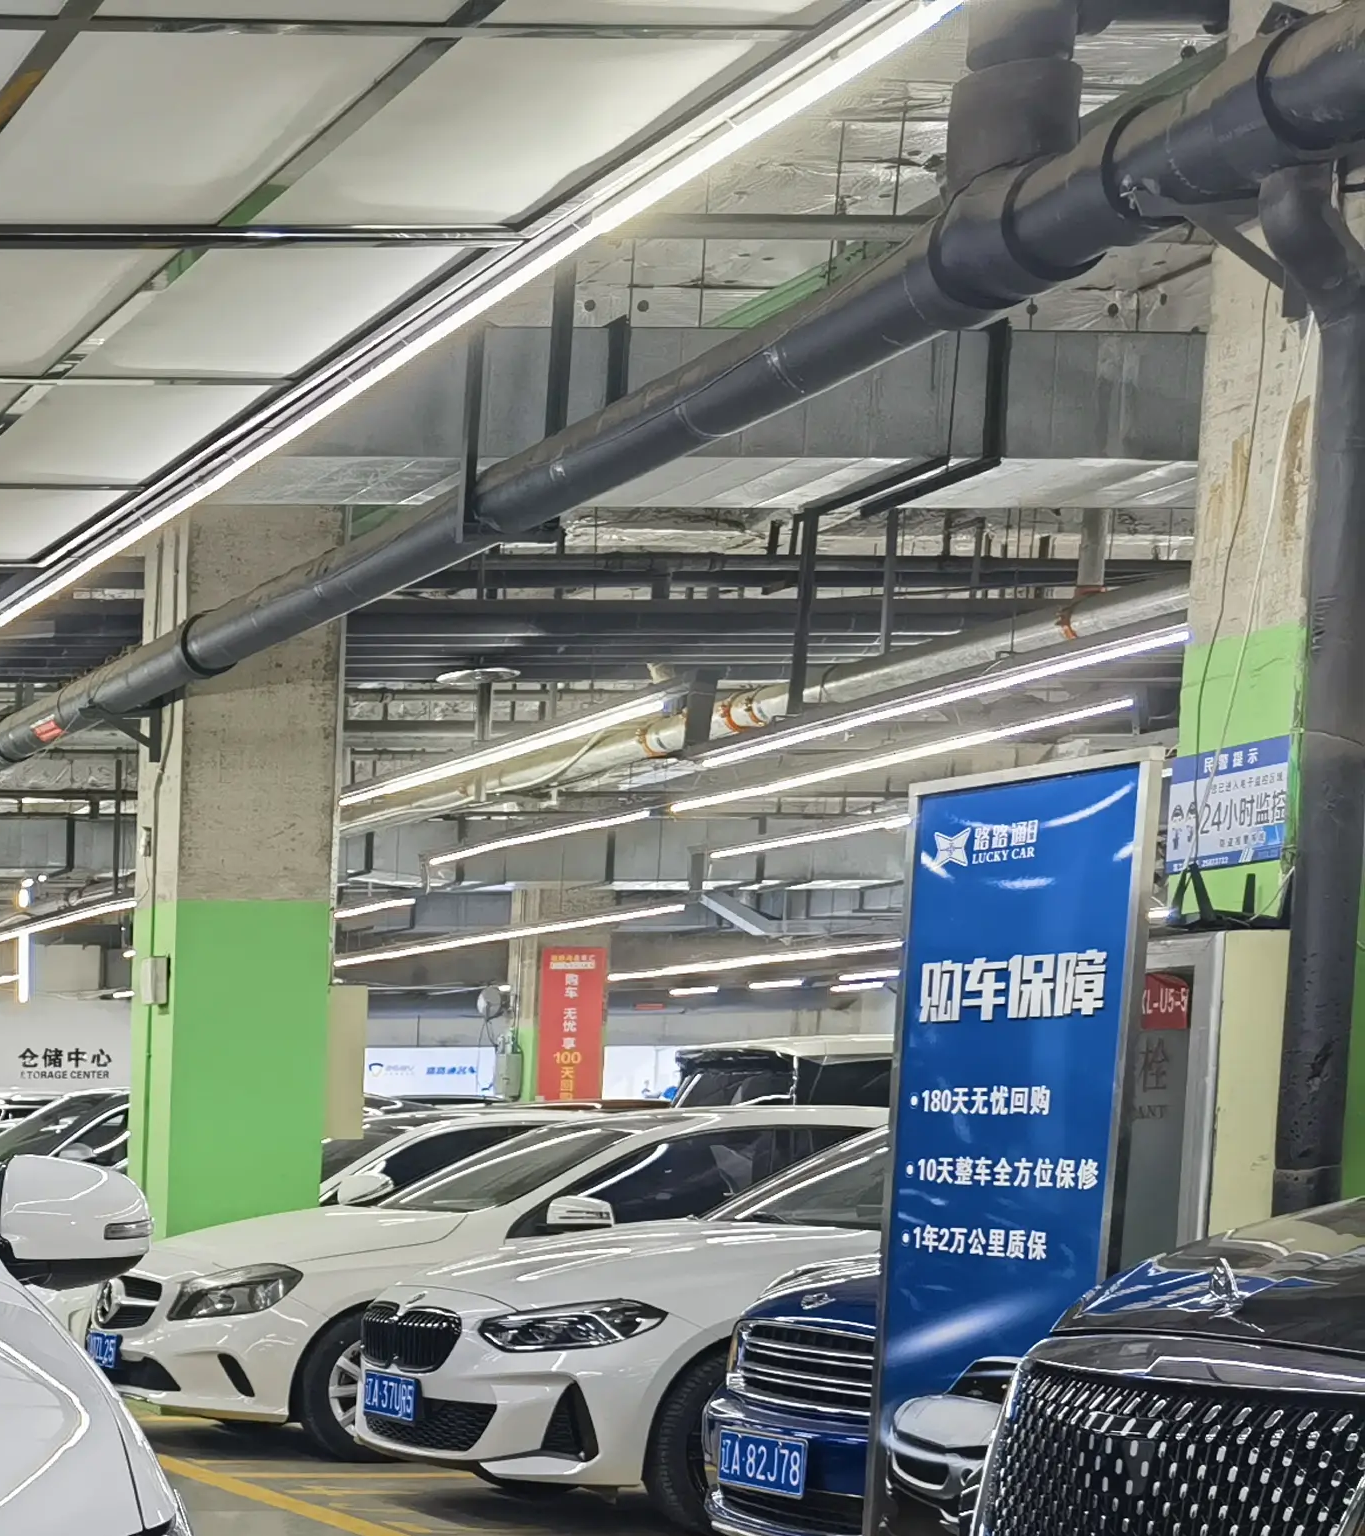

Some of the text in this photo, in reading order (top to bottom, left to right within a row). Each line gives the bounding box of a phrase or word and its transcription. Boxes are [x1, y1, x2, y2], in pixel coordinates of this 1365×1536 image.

[1200, 789, 1287, 835] 24小时监控
[973, 821, 1027, 851] 路路通
[972, 847, 1035, 864] LUCKY CAR
[919, 949, 1107, 1023] 购车保障
[18, 1048, 112, 1068] 仓储中心
[70, 1070, 109, 1079] CENTER
[921, 1085, 1050, 1116] 180天无忧回购
[917, 1157, 1098, 1190] 10天整车全方位保修
[913, 1227, 1048, 1260] 1年2万公里质保
